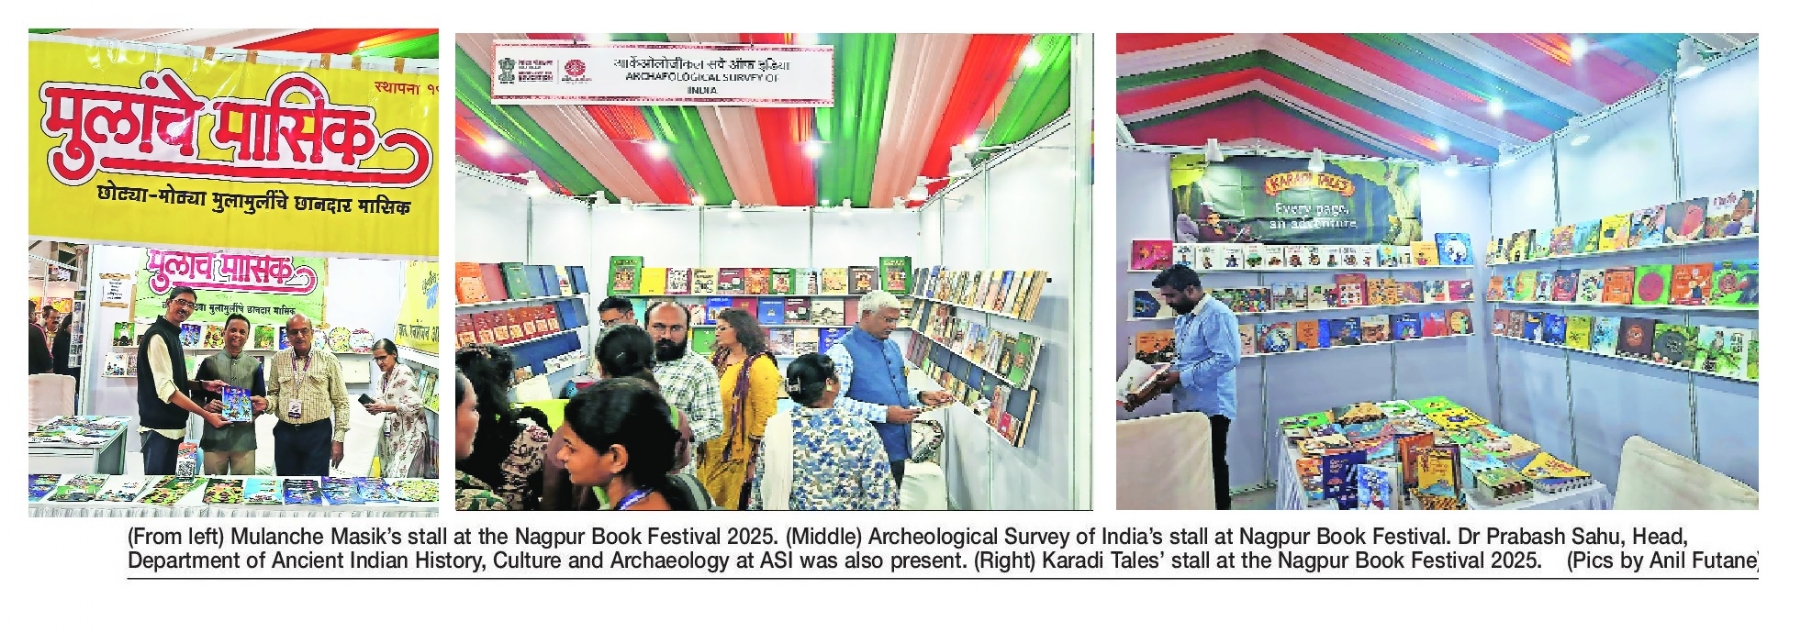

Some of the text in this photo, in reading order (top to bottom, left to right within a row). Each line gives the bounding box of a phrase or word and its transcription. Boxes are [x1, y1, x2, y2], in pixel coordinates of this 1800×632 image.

[374, 81, 420, 95] स्थापना
[687, 86, 718, 95] INDIA
[44, 72, 376, 180] मुलांचे मासिक
[212, 189, 289, 214] मुलामुलींचे
[294, 195, 353, 214] छानदार
[358, 194, 412, 216] मासिक
[1275, 202, 1312, 217] Every
[1269, 219, 1358, 230] an adventure
